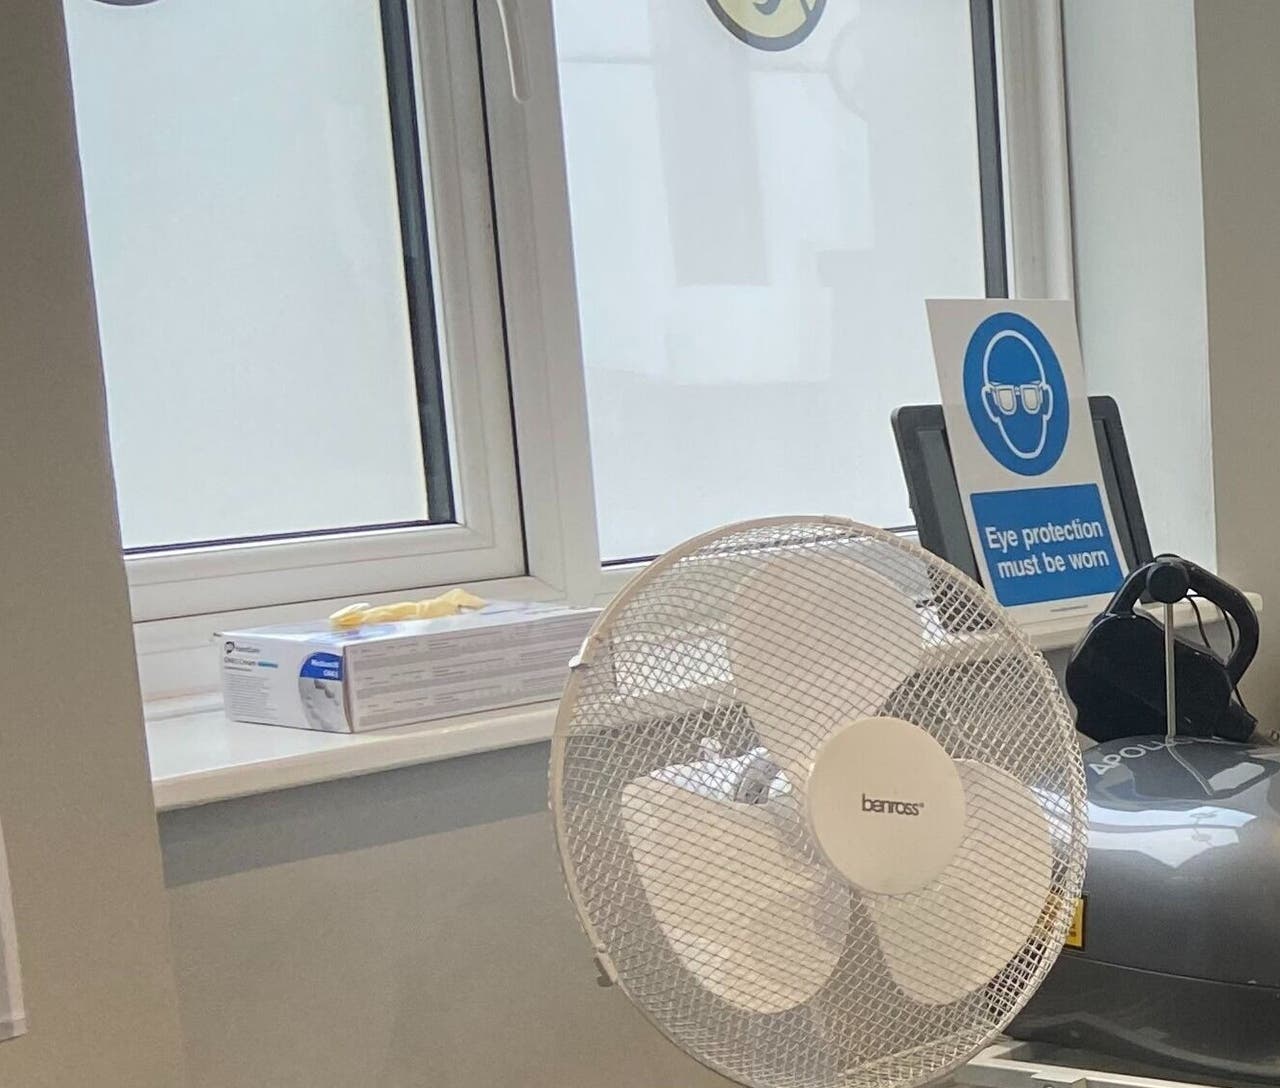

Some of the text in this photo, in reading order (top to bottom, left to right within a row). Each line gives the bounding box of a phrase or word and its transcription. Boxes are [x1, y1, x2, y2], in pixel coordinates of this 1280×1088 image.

[985, 518, 1103, 553] Eye protection
[997, 549, 1110, 578] must be worn
[861, 793, 920, 816] benross
